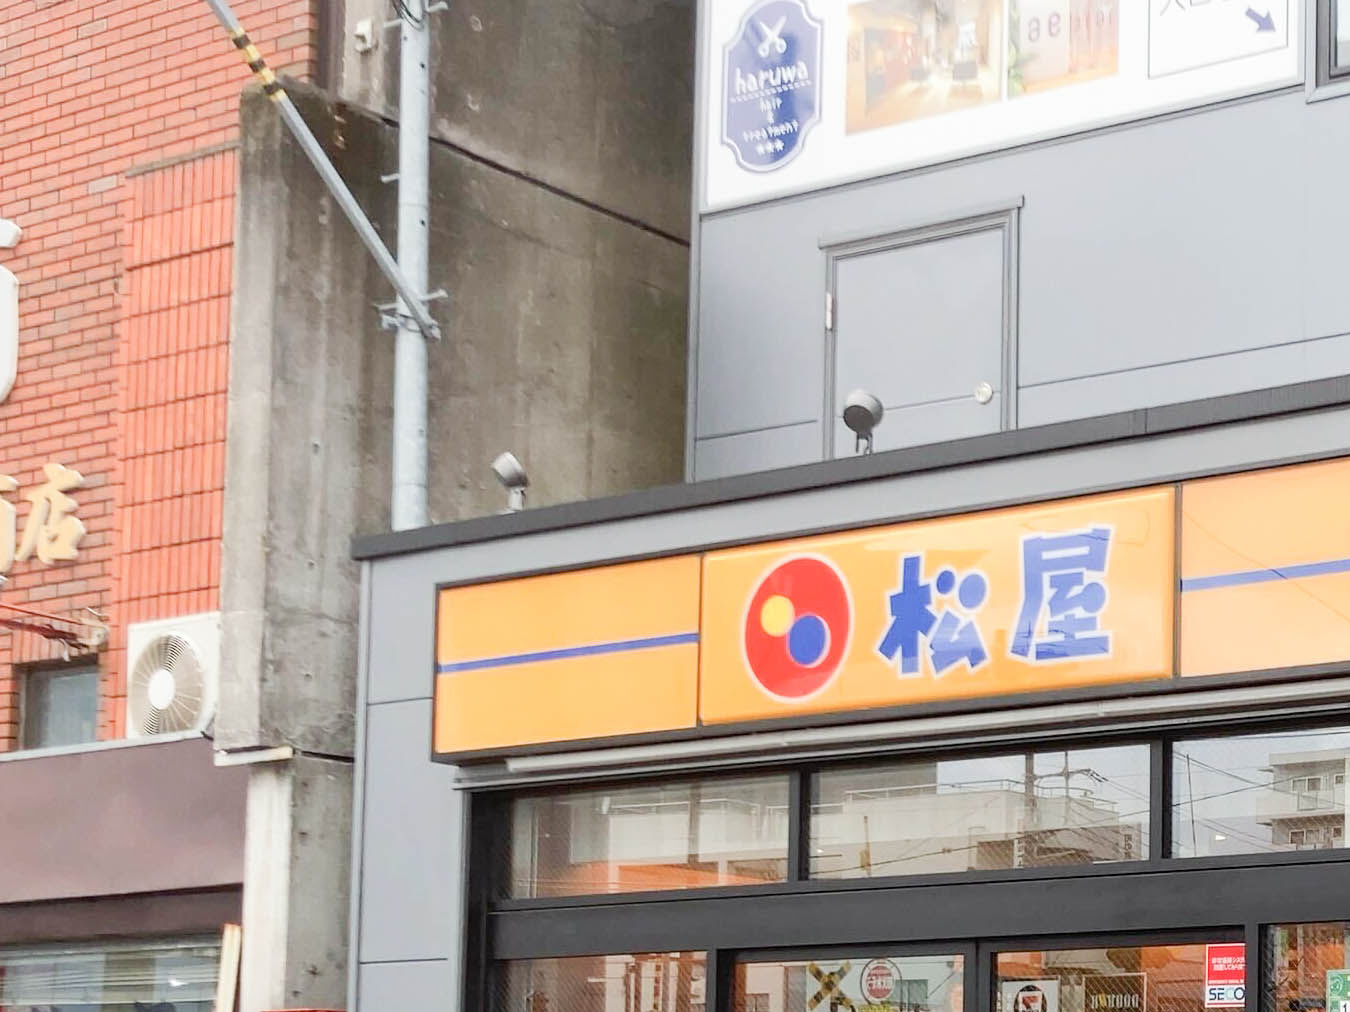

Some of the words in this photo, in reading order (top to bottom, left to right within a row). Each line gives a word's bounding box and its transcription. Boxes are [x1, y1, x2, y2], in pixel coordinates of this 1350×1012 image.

[735, 61, 809, 96] haruwa
[760, 97, 783, 113] hair
[743, 119, 800, 143] treatment
[0, 463, 87, 573] 店
[873, 523, 1116, 680] 松屋
